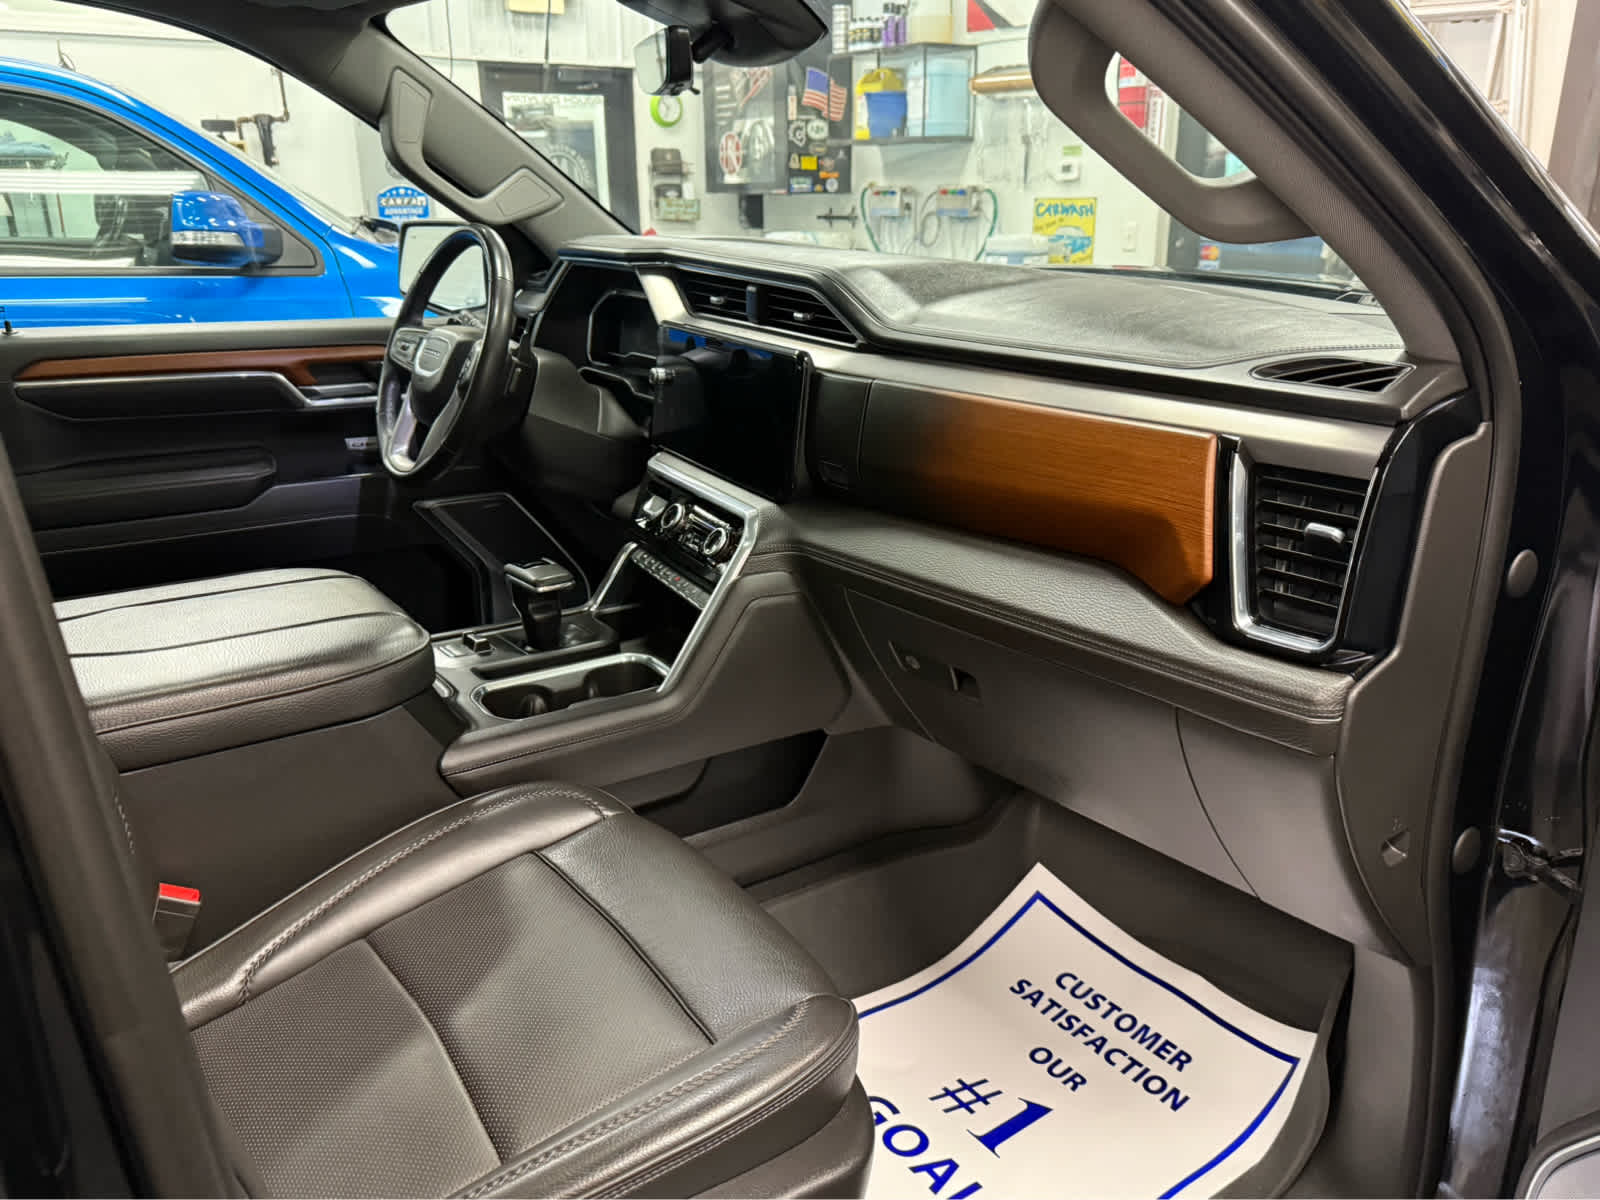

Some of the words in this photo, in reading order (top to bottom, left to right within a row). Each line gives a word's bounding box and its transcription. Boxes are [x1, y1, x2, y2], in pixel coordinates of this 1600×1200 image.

[1009, 978, 1190, 1112] SATISFACTION
[1055, 972, 1193, 1073] CUSTOMER
[1028, 1047, 1087, 1092] OUR
[929, 1078, 1054, 1158] #1
